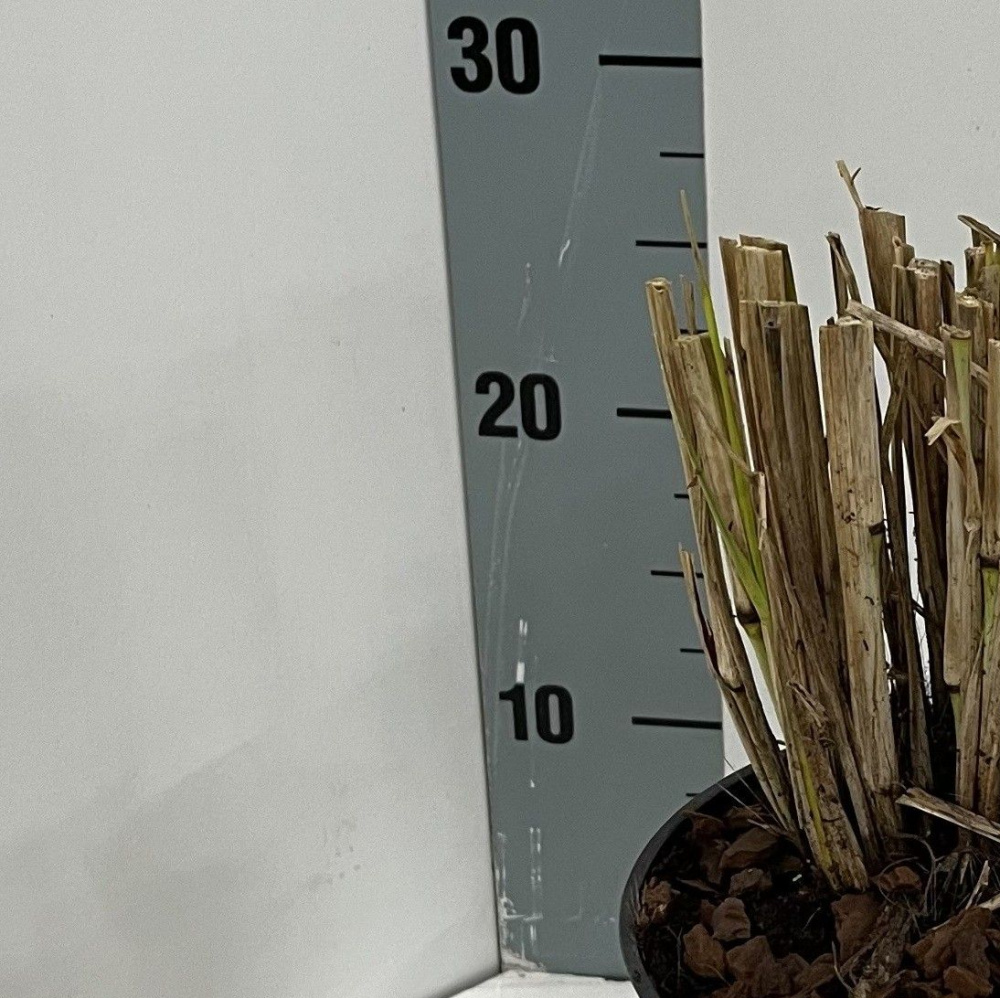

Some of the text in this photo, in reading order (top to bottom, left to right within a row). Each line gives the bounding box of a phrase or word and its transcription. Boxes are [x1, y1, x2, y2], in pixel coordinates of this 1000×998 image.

[447, 16, 542, 95] 30
[474, 371, 563, 441] 20
[499, 684, 575, 745] 10
